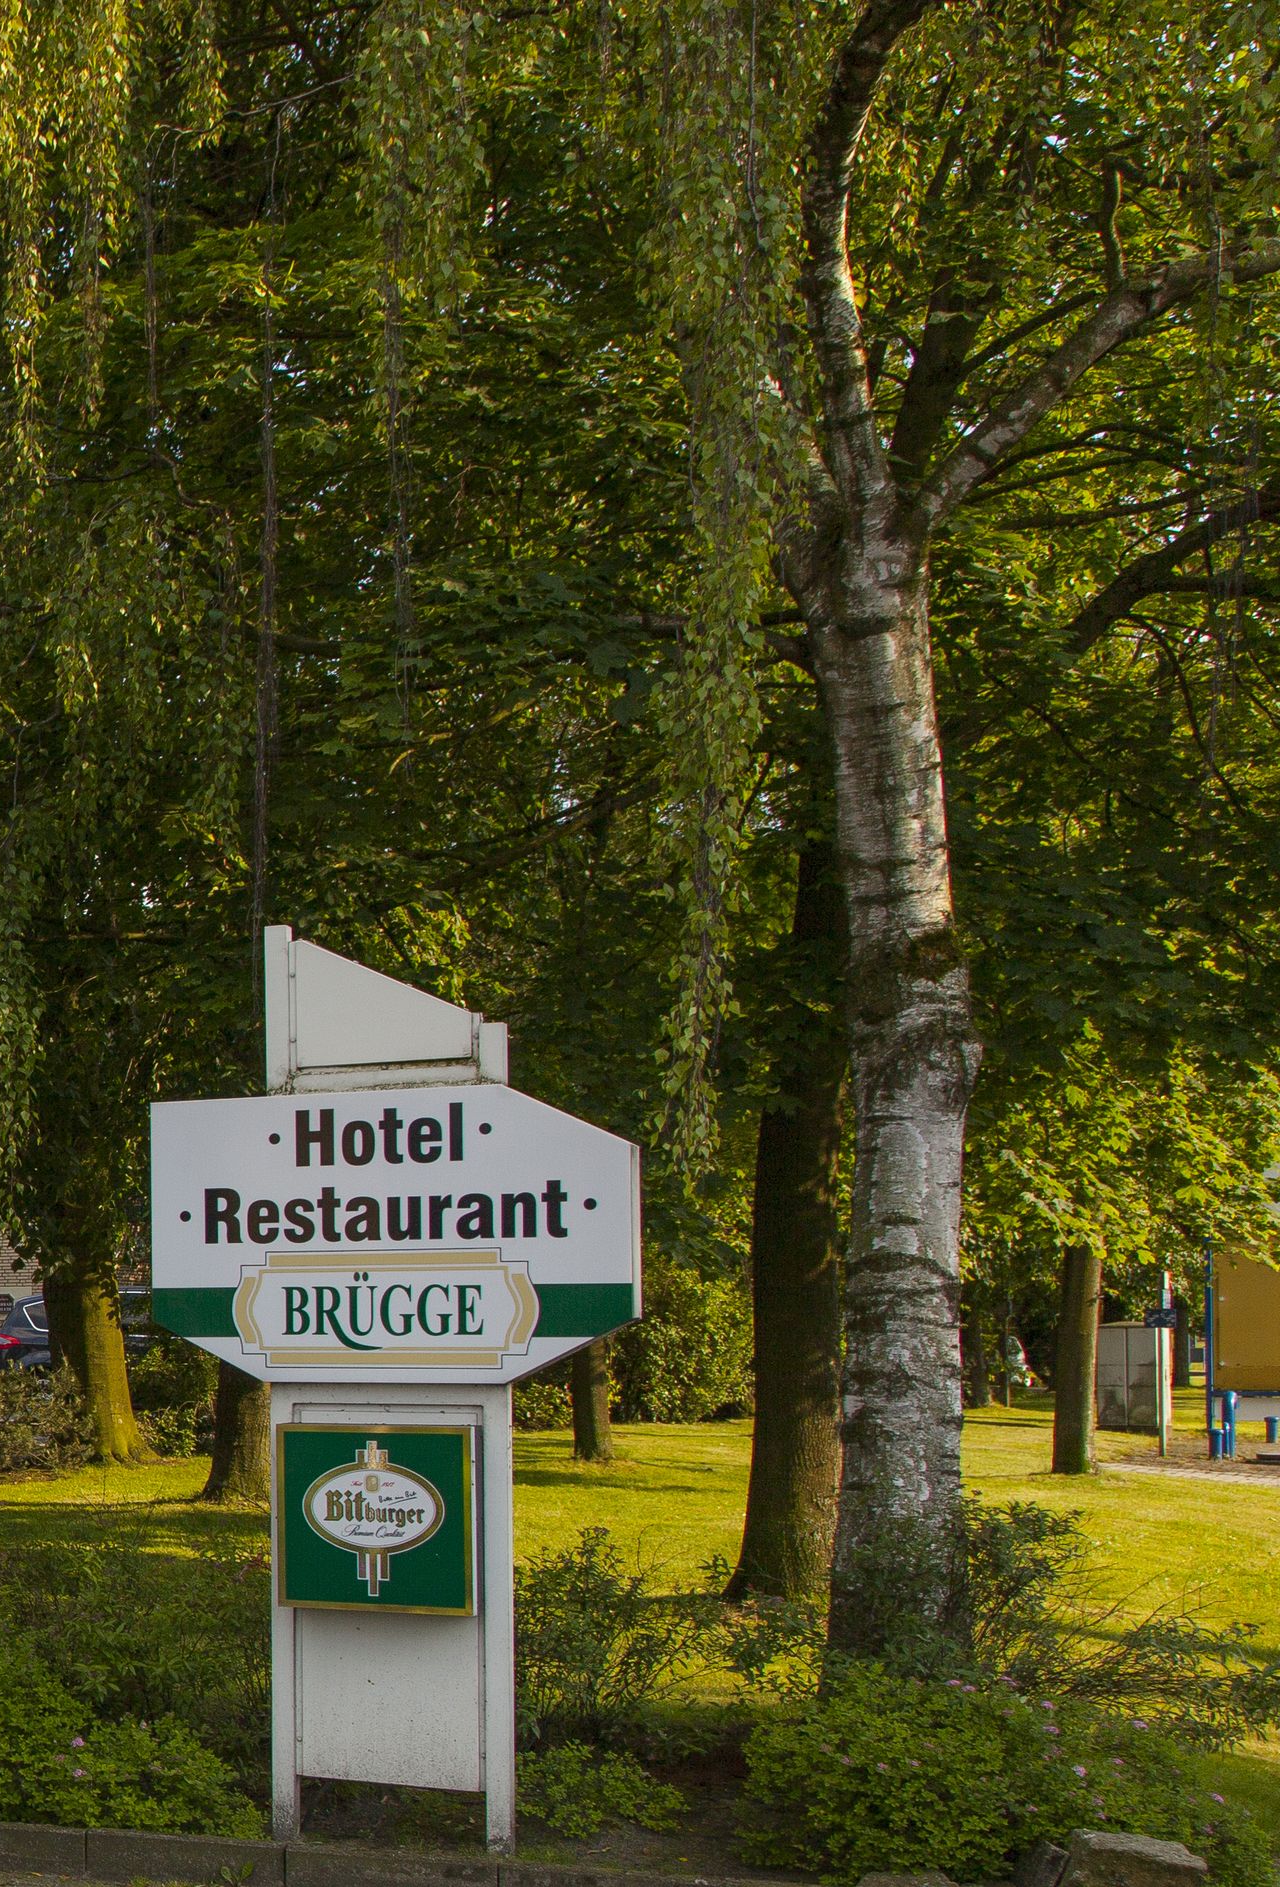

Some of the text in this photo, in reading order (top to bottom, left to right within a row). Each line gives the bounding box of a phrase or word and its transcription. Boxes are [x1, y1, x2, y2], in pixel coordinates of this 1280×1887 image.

[294, 1102, 464, 1167] Hotel
[203, 1179, 569, 1245] Restaurant
[281, 1271, 485, 1350] BRÜGGE
[323, 1489, 426, 1528] Bitburger
